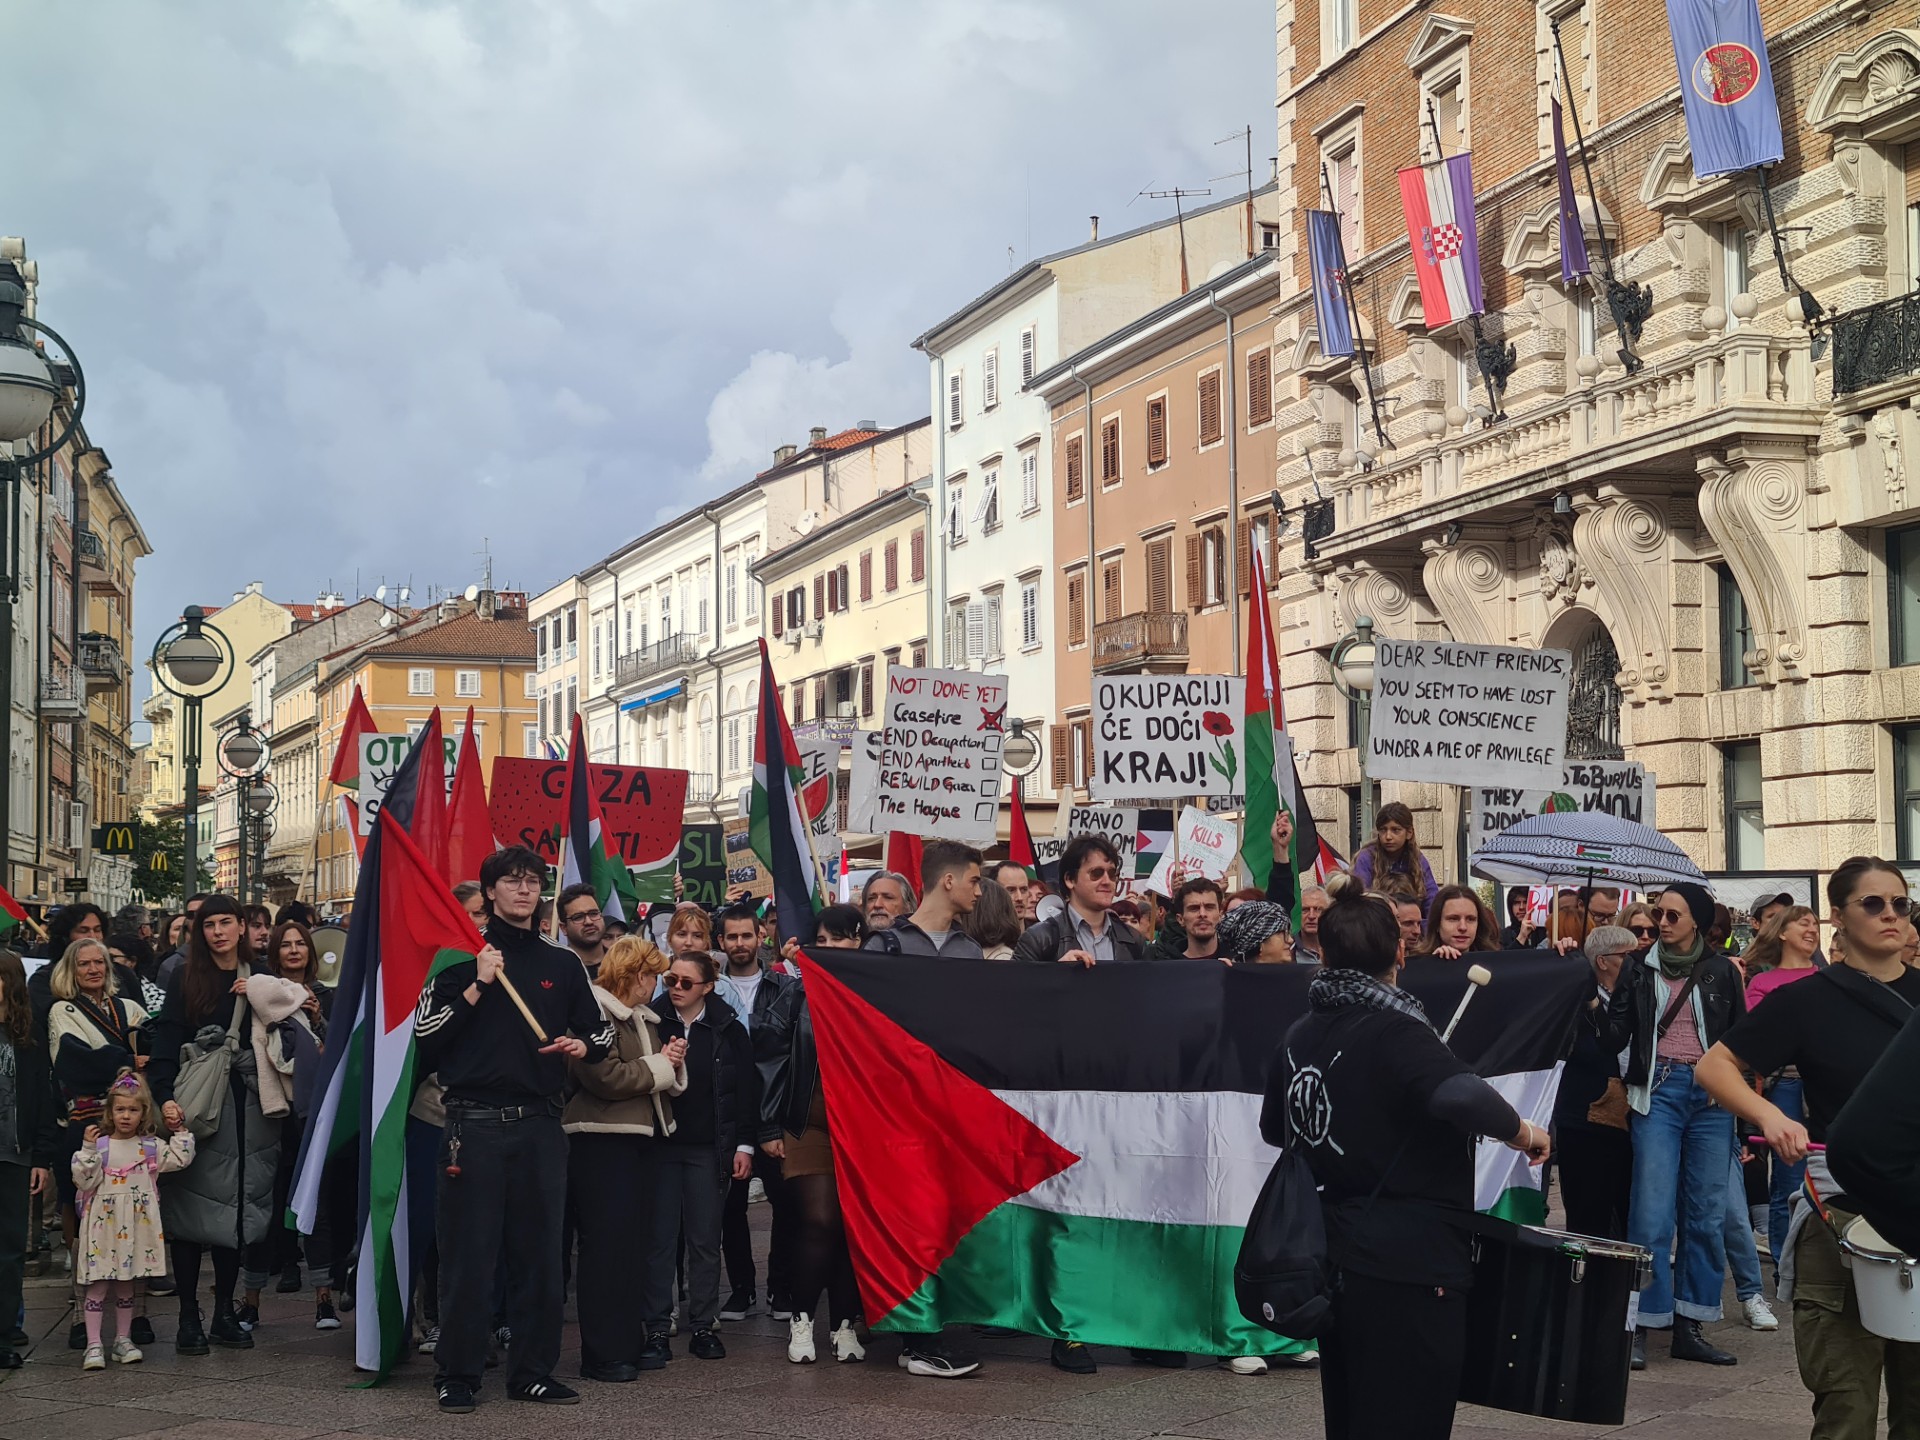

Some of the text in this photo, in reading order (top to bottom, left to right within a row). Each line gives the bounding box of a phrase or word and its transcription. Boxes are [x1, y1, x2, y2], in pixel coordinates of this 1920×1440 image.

[1381, 644, 1567, 680] DEAR SILENT FRIENDS,
[890, 675, 1002, 703] NOT DONE YET
[1099, 680, 1230, 711] OKUPACIJI
[1379, 678, 1556, 705] YOU SEEM TO HAVE LOST
[894, 702, 962, 727] Ceasefire
[1100, 709, 1202, 742] ĆE DOĆI
[1393, 705, 1538, 733] YOUR CONSCIENCE
[825, 732, 853, 740] HOSTE
[883, 727, 917, 748] END
[881, 748, 913, 769] END
[1373, 736, 1556, 766] UNDER A PILE OF PRIVILEGE
[880, 770, 940, 791] REBUILD
[1103, 751, 1207, 788] KRAJ!
[542, 766, 652, 806] GZA
[1482, 789, 1524, 807] THEY
[878, 795, 961, 824] The Hague
[1069, 809, 1124, 830] PRAVO
[1483, 808, 1537, 831] DIDN'
[1189, 824, 1224, 849] KILLS
